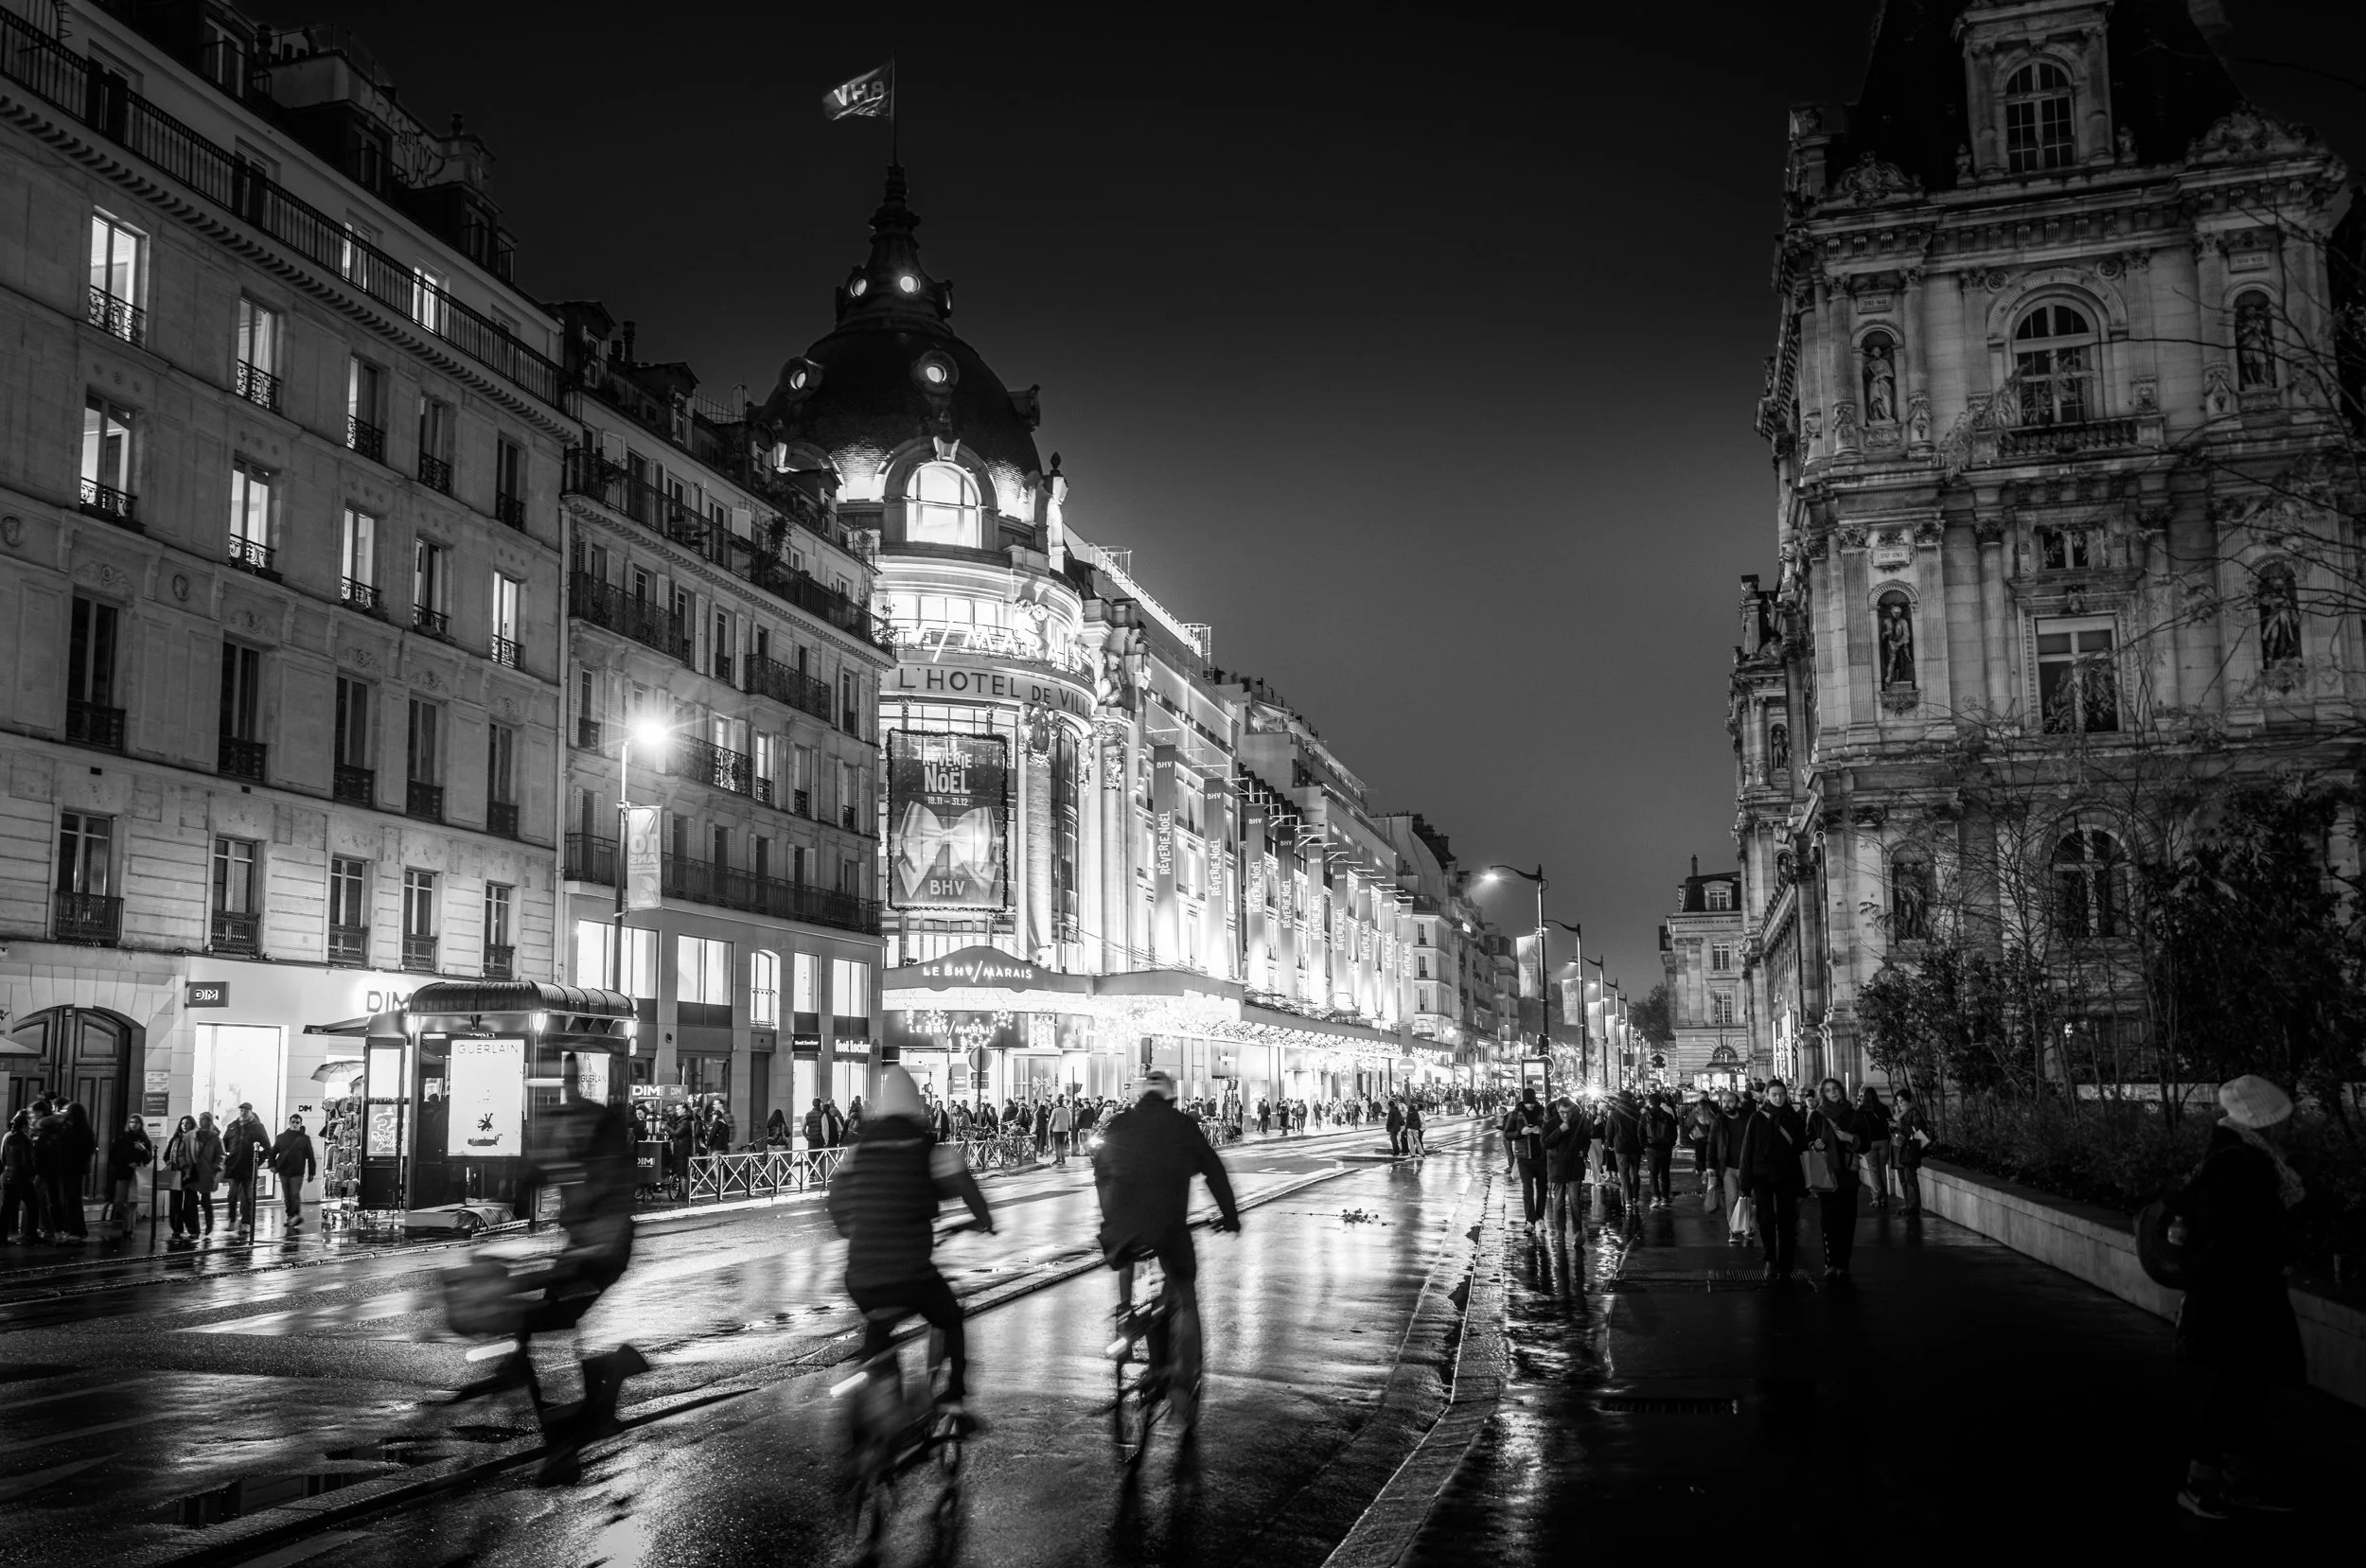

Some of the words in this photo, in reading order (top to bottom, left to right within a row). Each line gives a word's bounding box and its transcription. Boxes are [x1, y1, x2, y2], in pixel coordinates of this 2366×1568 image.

[899, 667, 1020, 698] L'HOTEL
[1032, 684, 1051, 703] DE
[923, 750, 973, 769] RVERIE
[925, 763, 971, 794] NOËL
[951, 797, 968, 805] 31.12
[1157, 811, 1171, 833] NOËL
[1156, 836, 1172, 874] RÊVERIE
[1209, 837, 1221, 858] NOËL
[1250, 859, 1262, 878] NOËL
[930, 880, 964, 896] BHV
[1208, 861, 1222, 896] RÊVERIE
[1249, 880, 1262, 912] RÊVERIE
[923, 966, 940, 977] LE
[195, 989, 219, 1000] DIM
[909, 1025, 923, 1033] LE
[457, 1045, 519, 1054] GUERLAIN
[580, 1074, 607, 1083] GUERLAIN
[632, 1085, 661, 1097] DIM
